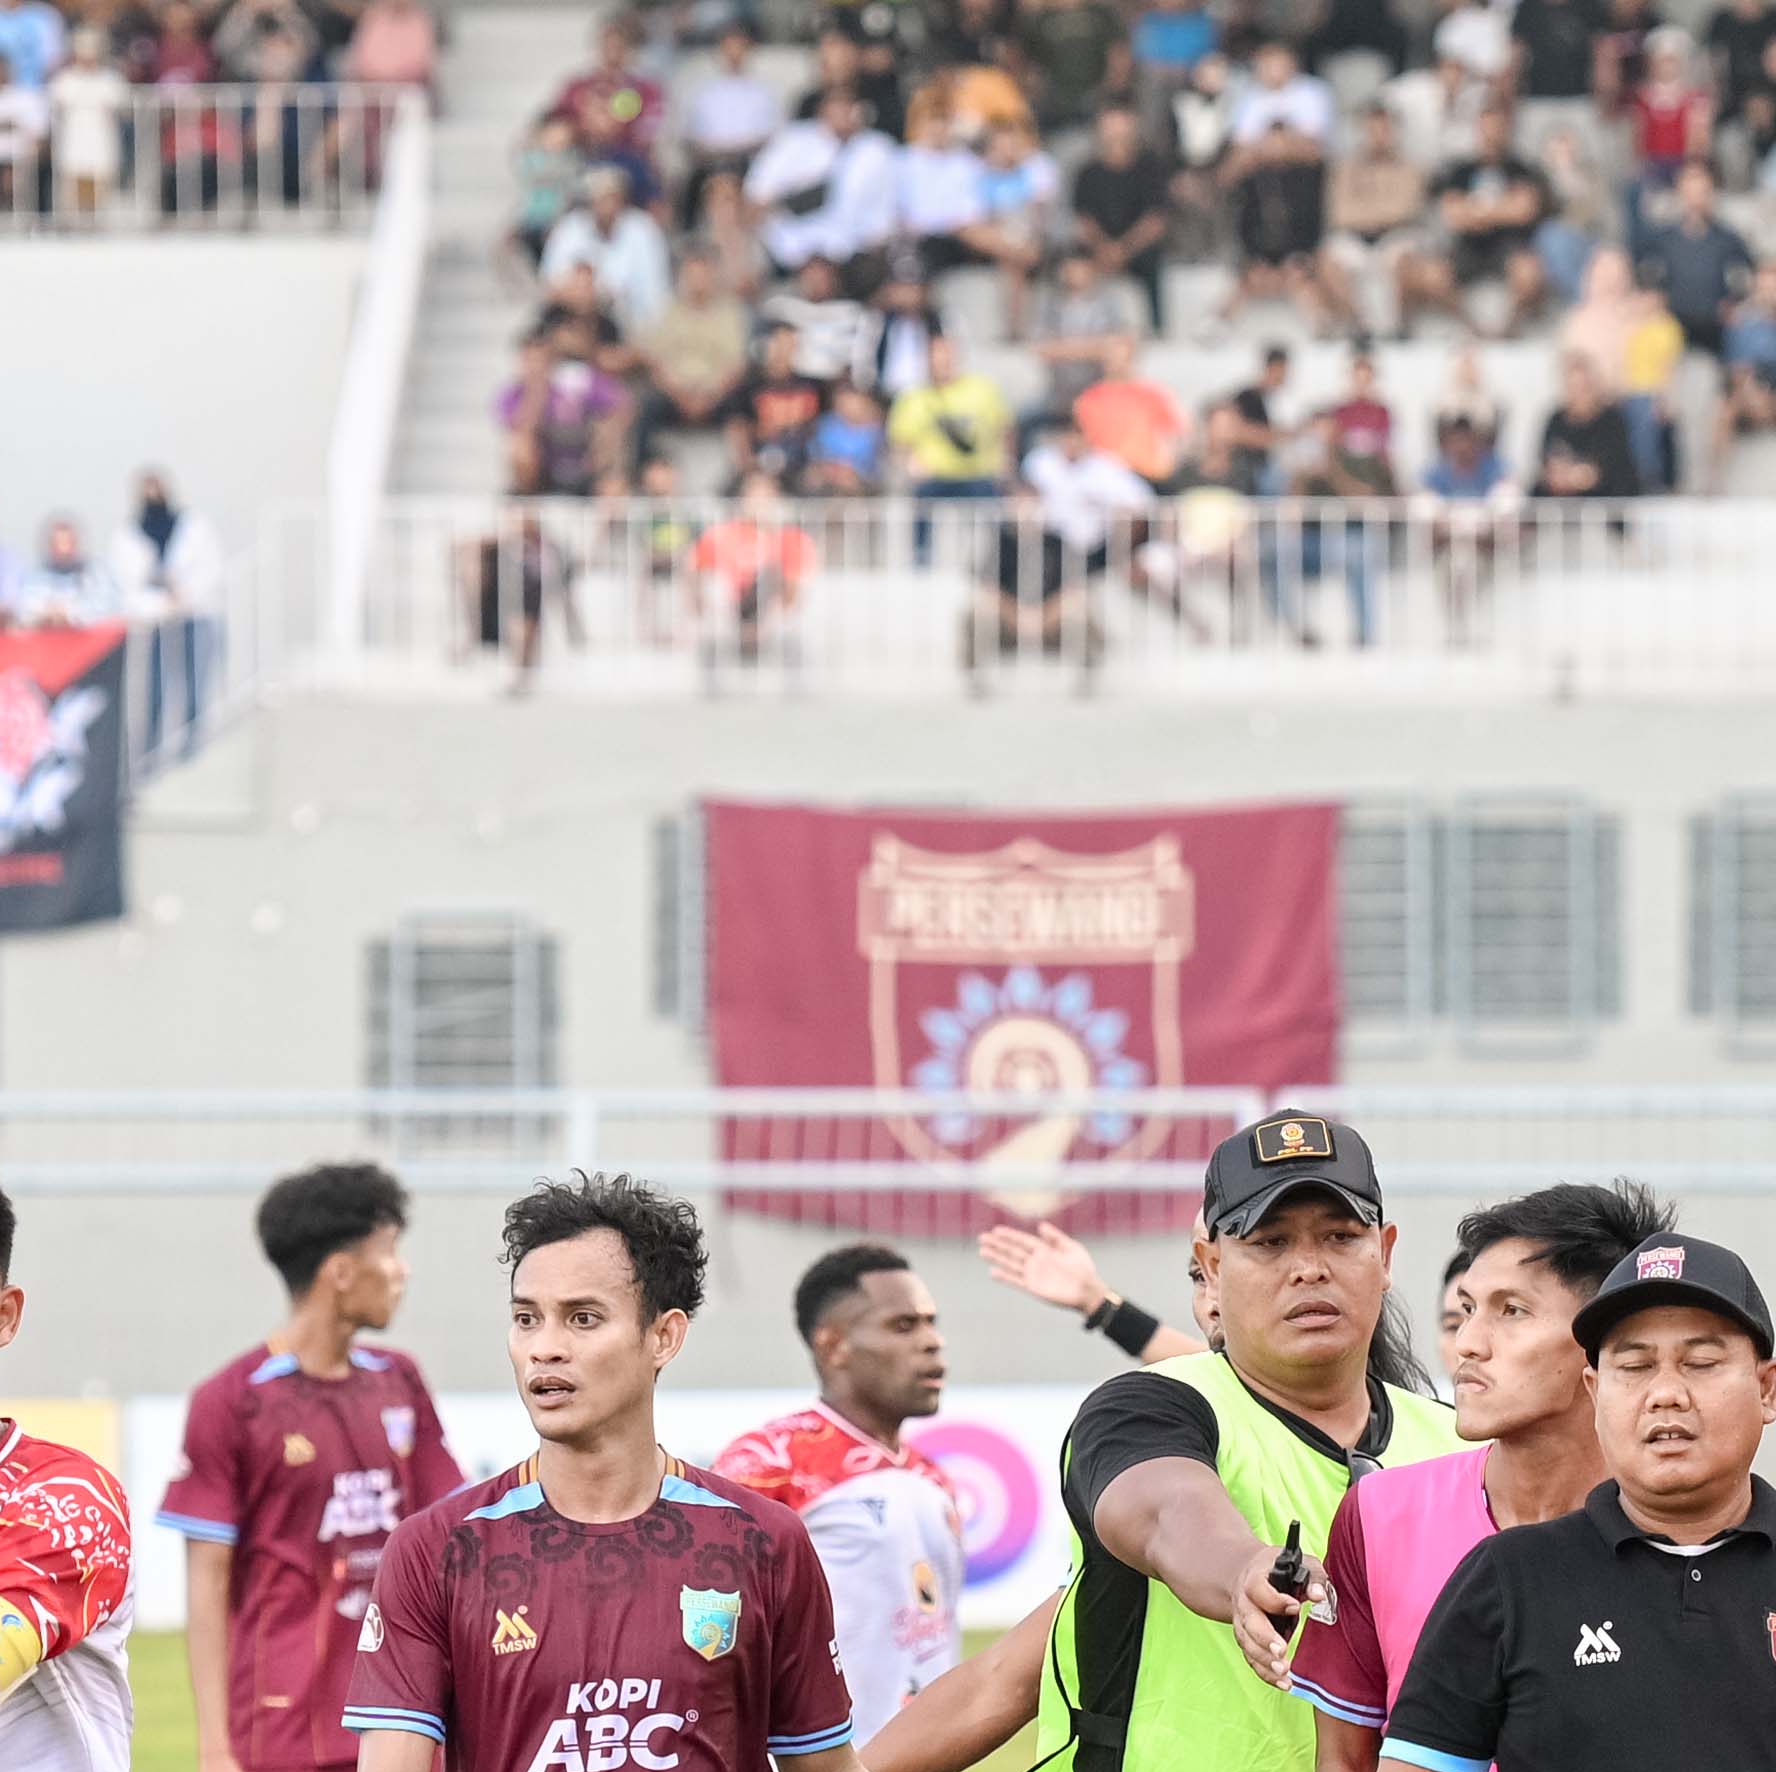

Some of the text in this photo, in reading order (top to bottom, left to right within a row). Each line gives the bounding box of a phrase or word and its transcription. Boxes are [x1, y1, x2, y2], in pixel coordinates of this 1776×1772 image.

[492, 1637, 538, 1656] TMSW
[1574, 1651, 1621, 1667] TMSW
[566, 1678, 662, 1714] KOPI
